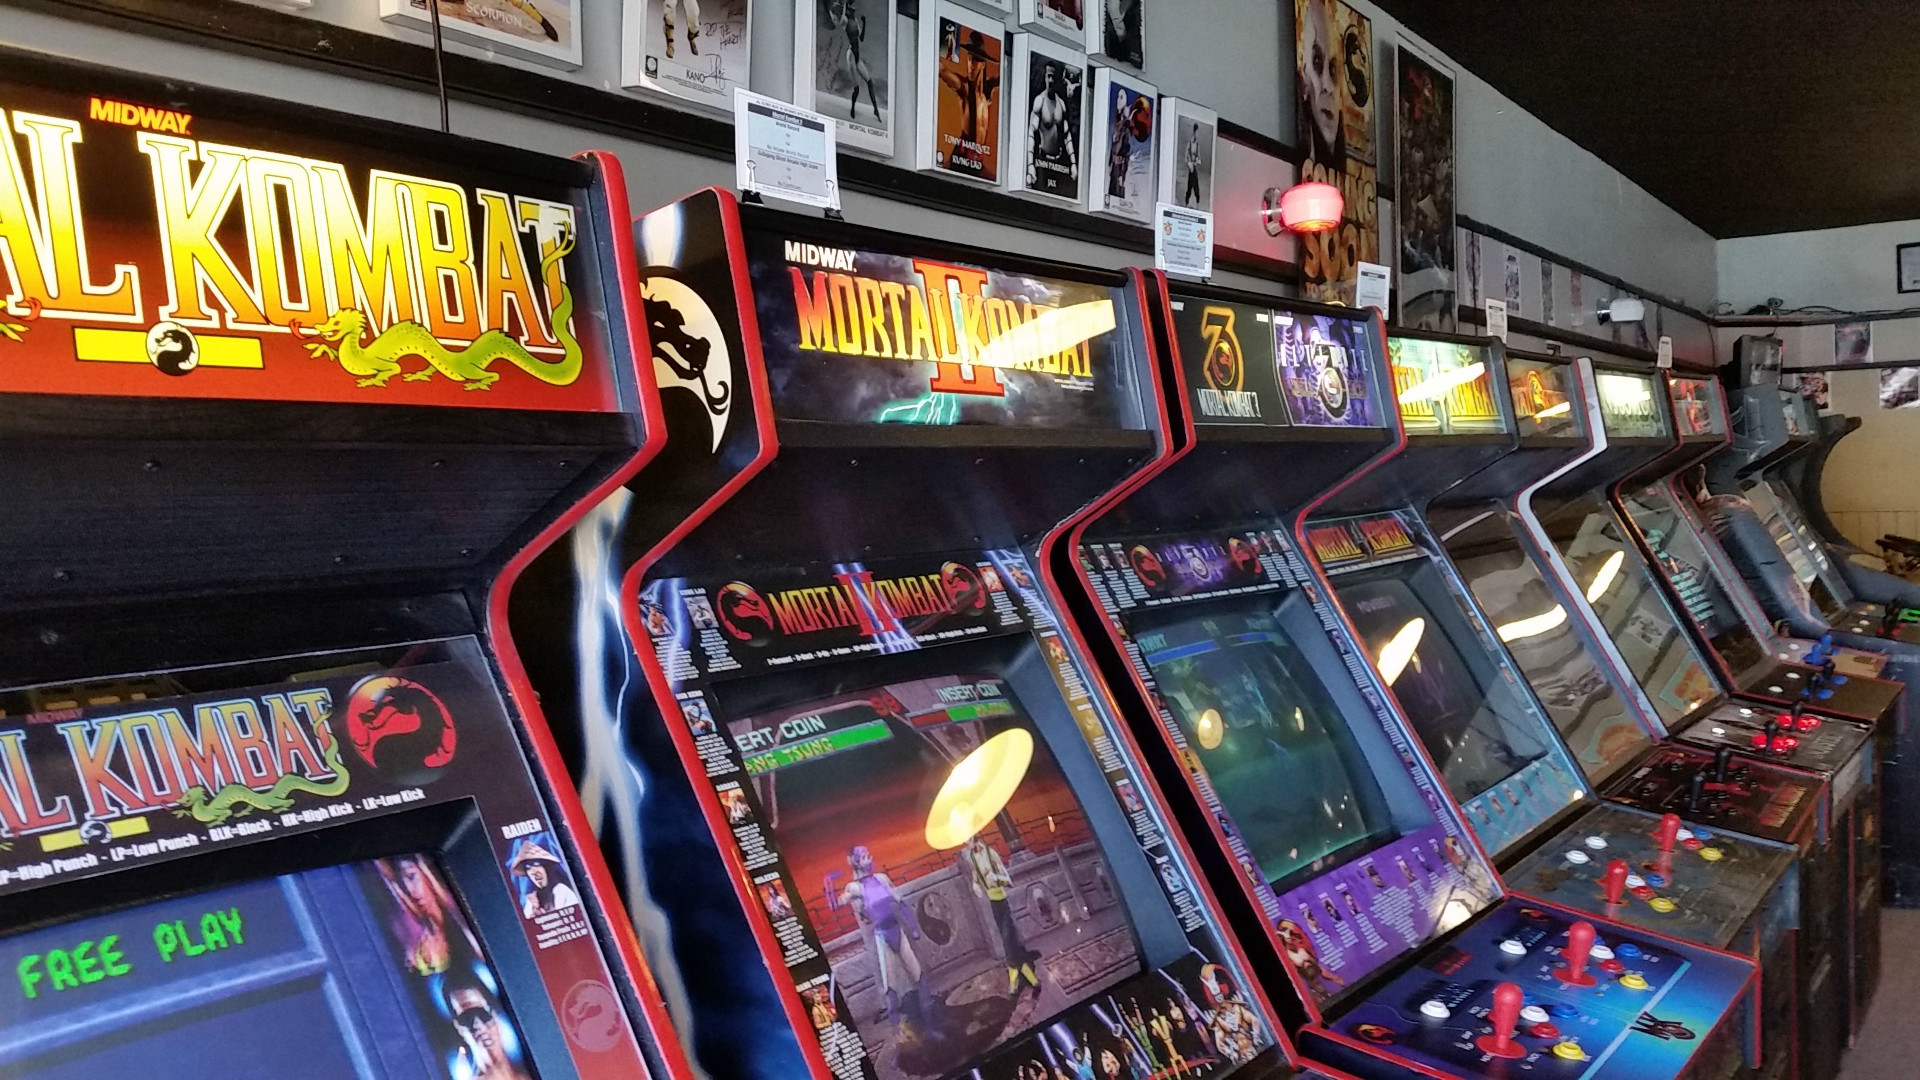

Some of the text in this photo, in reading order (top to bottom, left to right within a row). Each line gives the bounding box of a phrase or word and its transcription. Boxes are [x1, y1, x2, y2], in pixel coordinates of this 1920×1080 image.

[465, 2, 524, 28] SCORPION
[686, 69, 706, 84] KANO
[89, 97, 193, 136] MIDWAY
[943, 133, 962, 147] TONY
[1047, 177, 1057, 188] JAX
[138, 130, 576, 356] KOMBAT
[784, 239, 858, 273] MIDWAY
[787, 266, 960, 364] MORTAL
[767, 582, 876, 637] MORTAL
[862, 573, 951, 625] KOMBAT
[935, 683, 980, 703] INSERT
[779, 714, 827, 739] COIN
[55, 687, 334, 820] KOMBAT
[0, 862, 55, 885] P=High
[52, 852, 99, 873] Punch
[109, 842, 158, 861] LP=Low
[157, 832, 200, 852] Punch
[208, 818, 273, 842] BLK=Block
[280, 806, 331, 828] HK=High
[329, 801, 355, 818] Kick
[400, 787, 426, 801] Kick
[501, 818, 543, 840] RAIDEN
[16, 906, 246, 999] FREE PLAY
